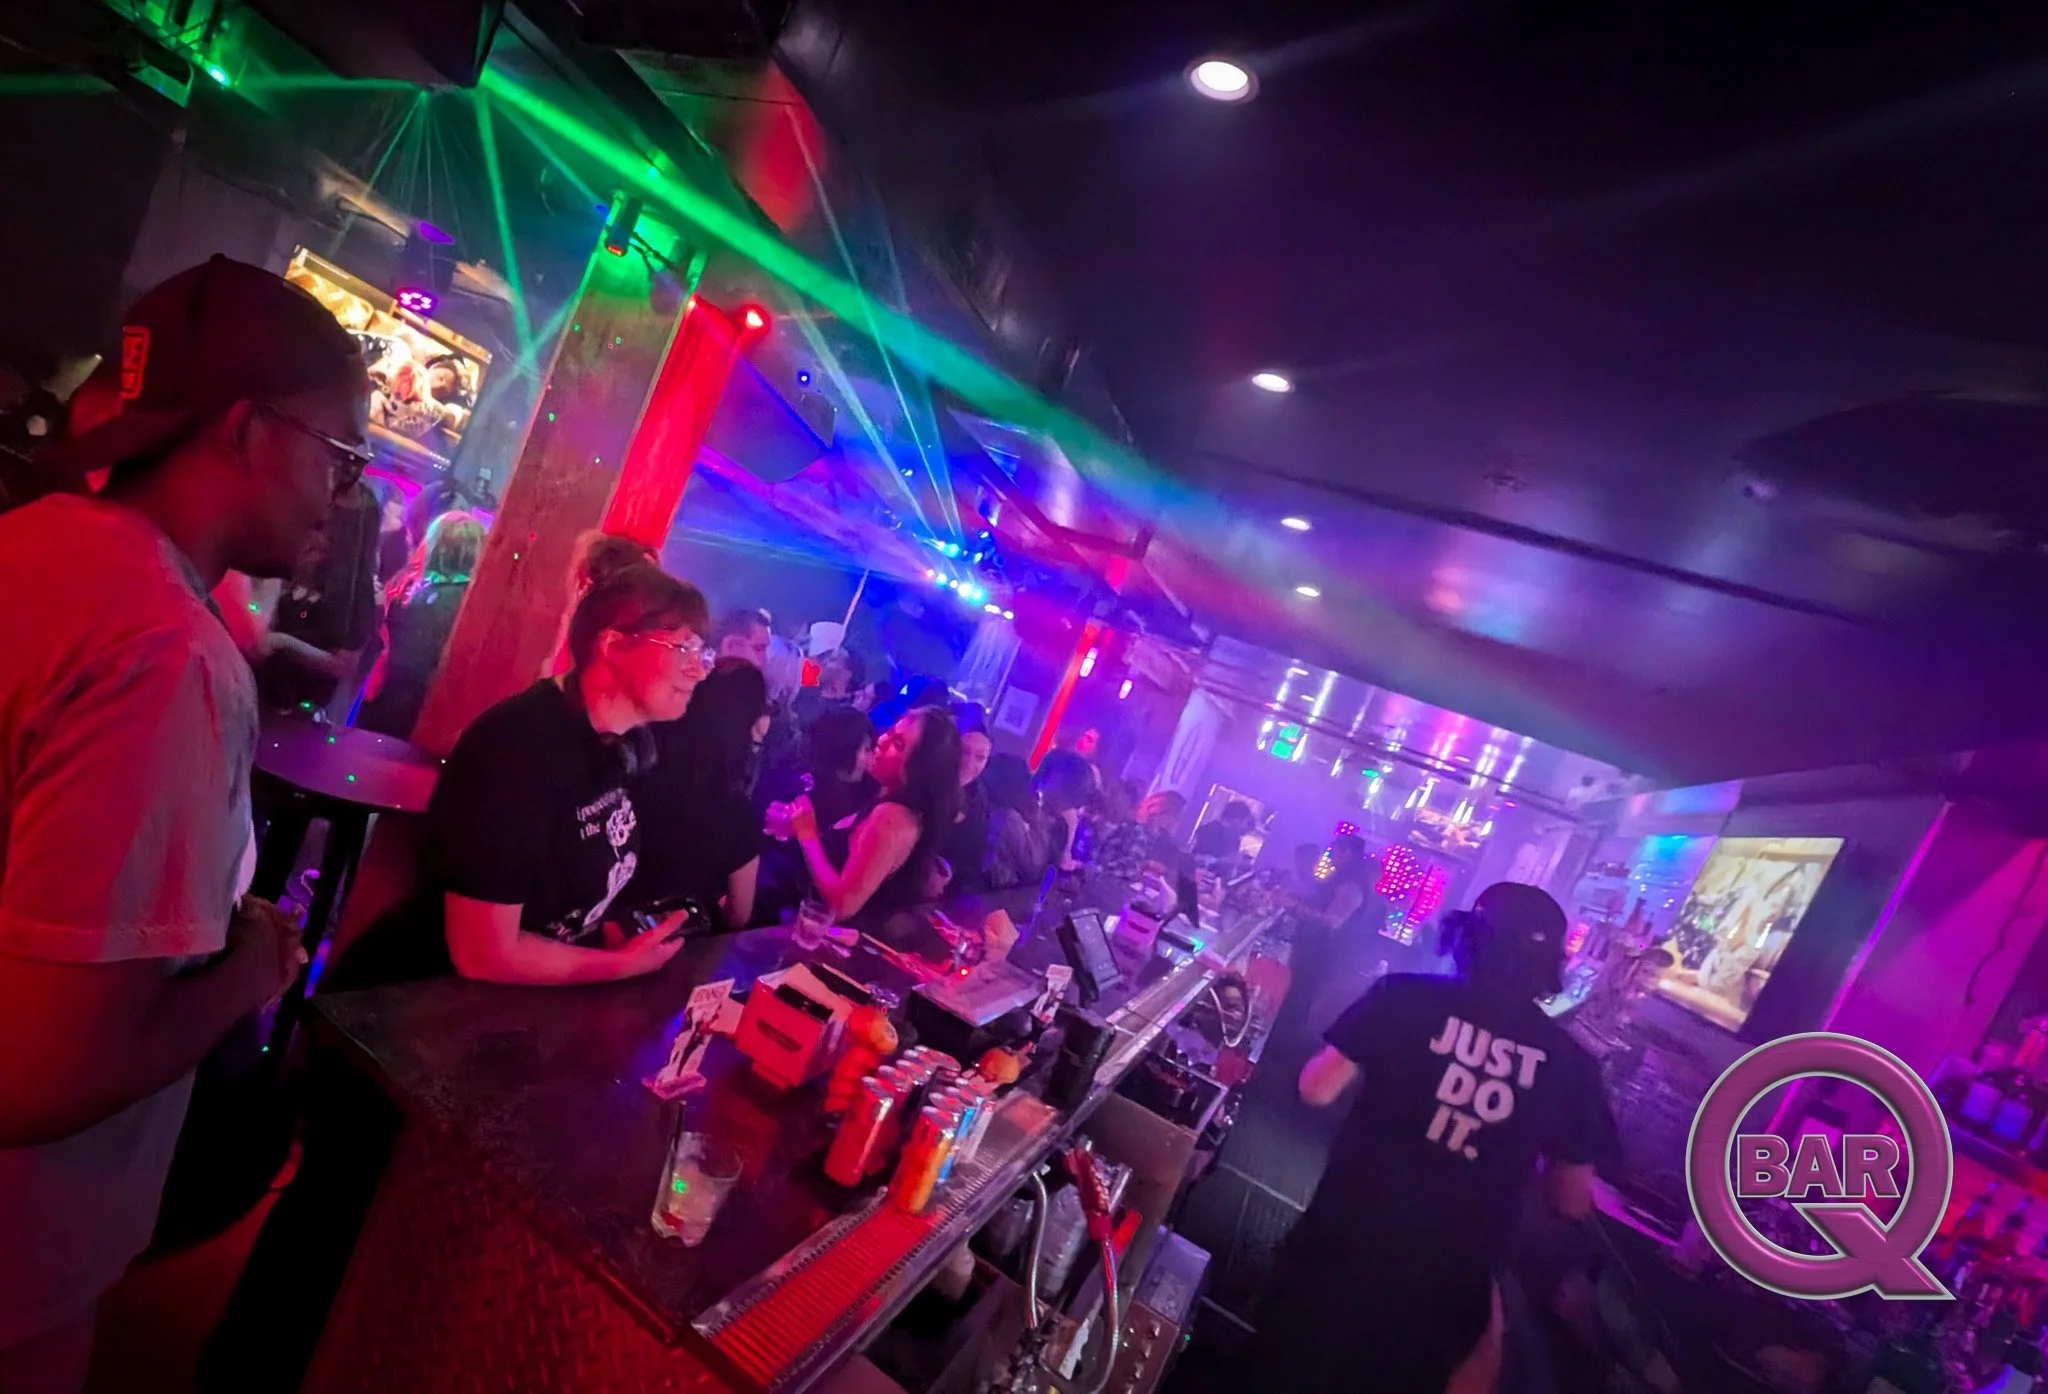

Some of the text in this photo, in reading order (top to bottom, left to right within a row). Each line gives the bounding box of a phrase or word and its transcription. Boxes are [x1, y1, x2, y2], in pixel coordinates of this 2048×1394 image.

[1429, 1016, 1547, 1090] JUST
[1435, 1061, 1515, 1122] DO
[1425, 1104, 1479, 1160] IT.
